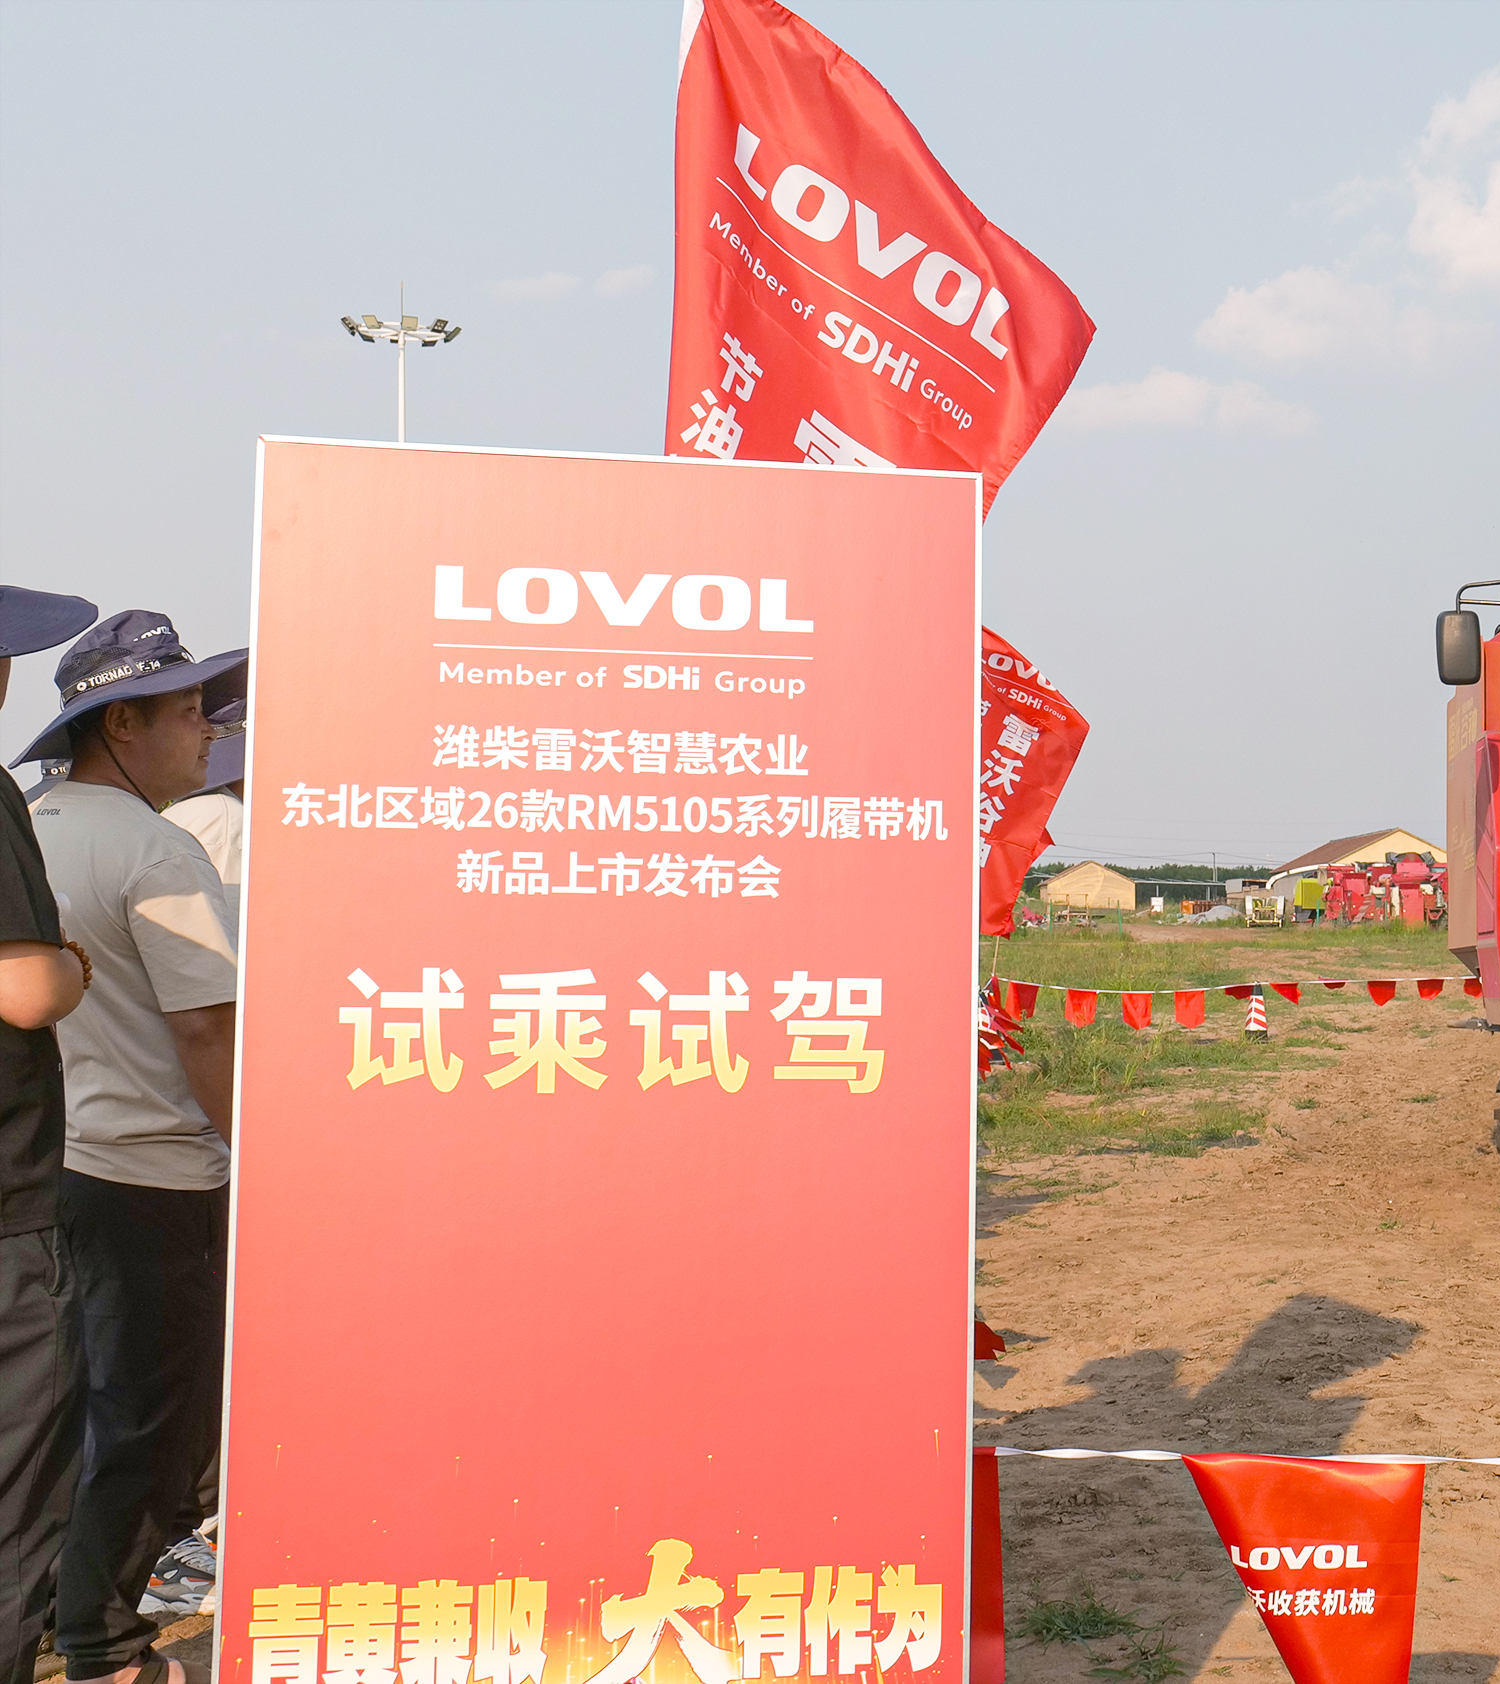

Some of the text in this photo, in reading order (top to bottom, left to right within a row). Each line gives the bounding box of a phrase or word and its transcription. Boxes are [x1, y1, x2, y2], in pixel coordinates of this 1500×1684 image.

[734, 122, 1010, 361] LOVOL
[708, 212, 973, 430] Member of SDHi Group
[434, 564, 814, 633] LOVOL
[87, 664, 138, 687] TORNAD
[440, 661, 806, 699] Member of SDHi Group
[1007, 688, 1043, 710] SDHi
[1043, 704, 1067, 721] Group
[432, 724, 809, 777] 潍柴雷沃智慧农业
[281, 781, 949, 842] 东北区域26款RM5105系列履带机
[456, 848, 783, 899] 新品上市发布会
[338, 966, 886, 1095] 试乘试驾
[1230, 1543, 1368, 1571] LOVOL
[248, 1538, 943, 1684] 青黄兼收 大有作为
